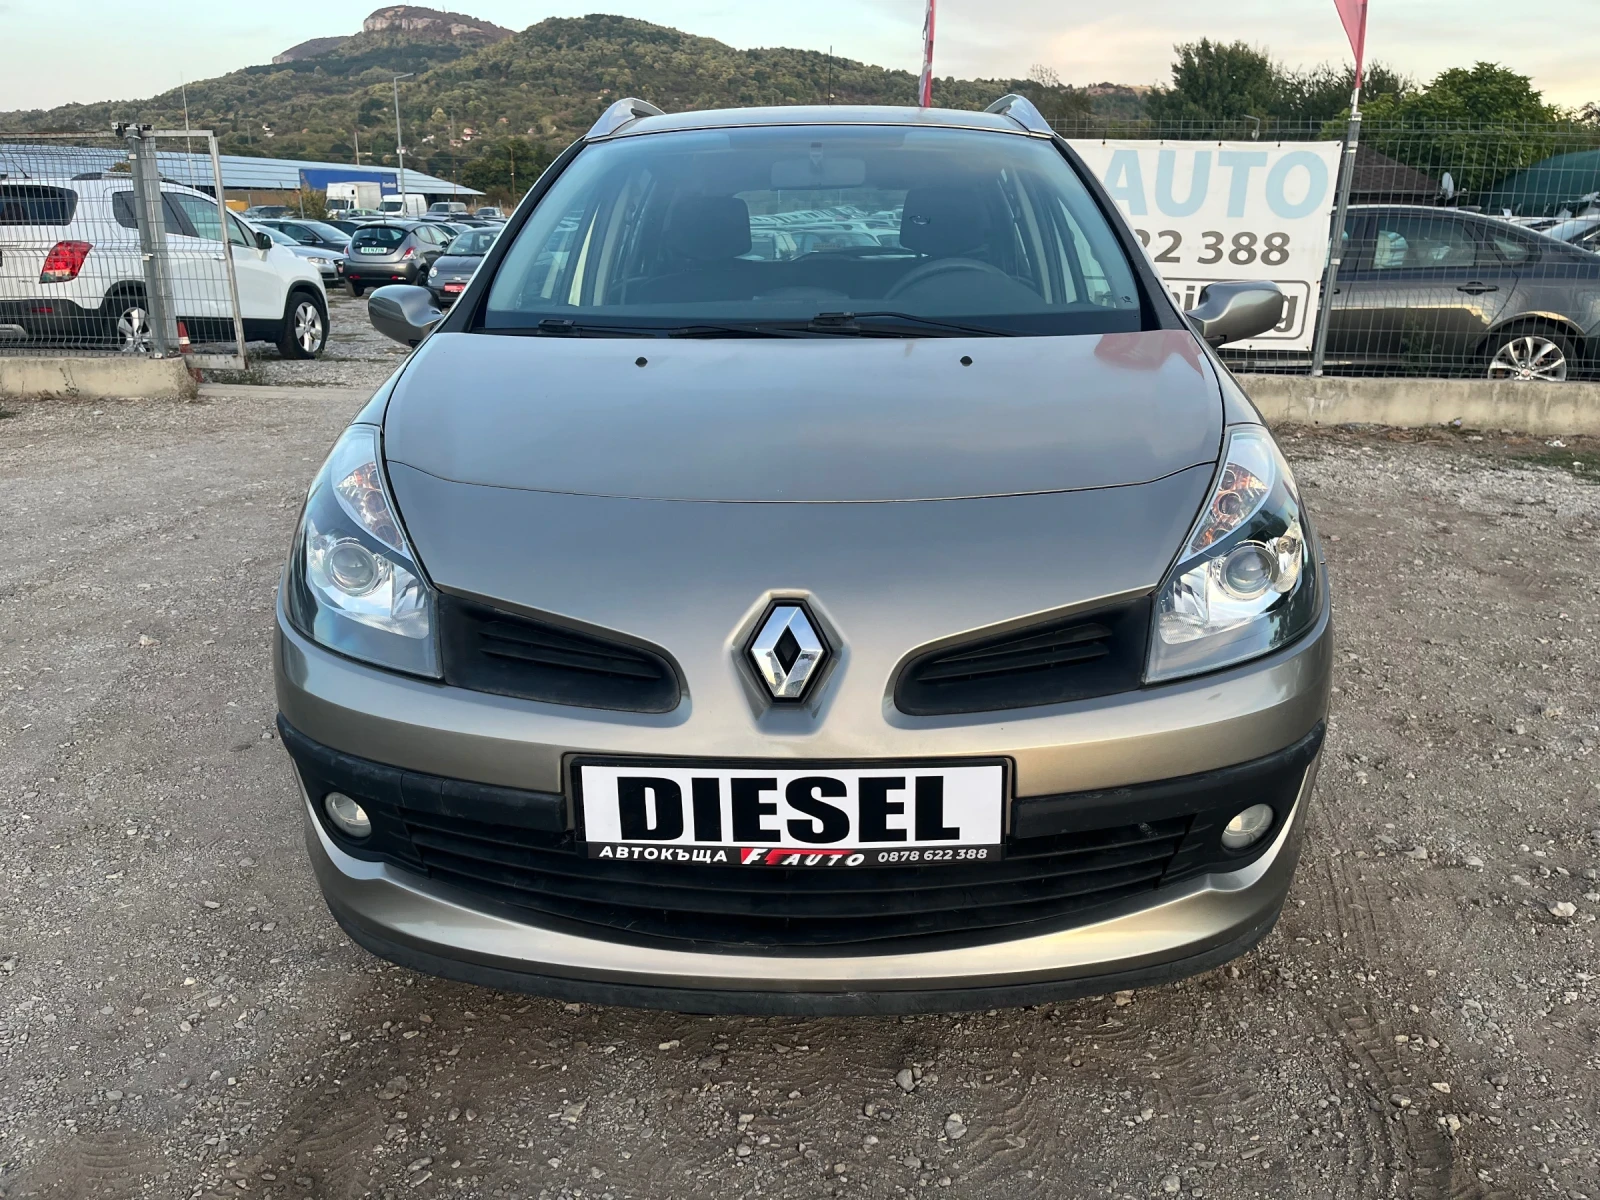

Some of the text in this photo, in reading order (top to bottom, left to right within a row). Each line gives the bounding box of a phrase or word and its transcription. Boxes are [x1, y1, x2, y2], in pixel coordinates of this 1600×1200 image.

[1103, 150, 1329, 219] AUTO
[1197, 230, 1290, 266] 388
[616, 775, 960, 844] DIESEL
[599, 845, 727, 864] АВТОКЪЩА
[781, 853, 865, 867] AUTO
[877, 851, 920, 863] 0878
[923, 850, 953, 861] 622
[956, 848, 988, 860] 388
